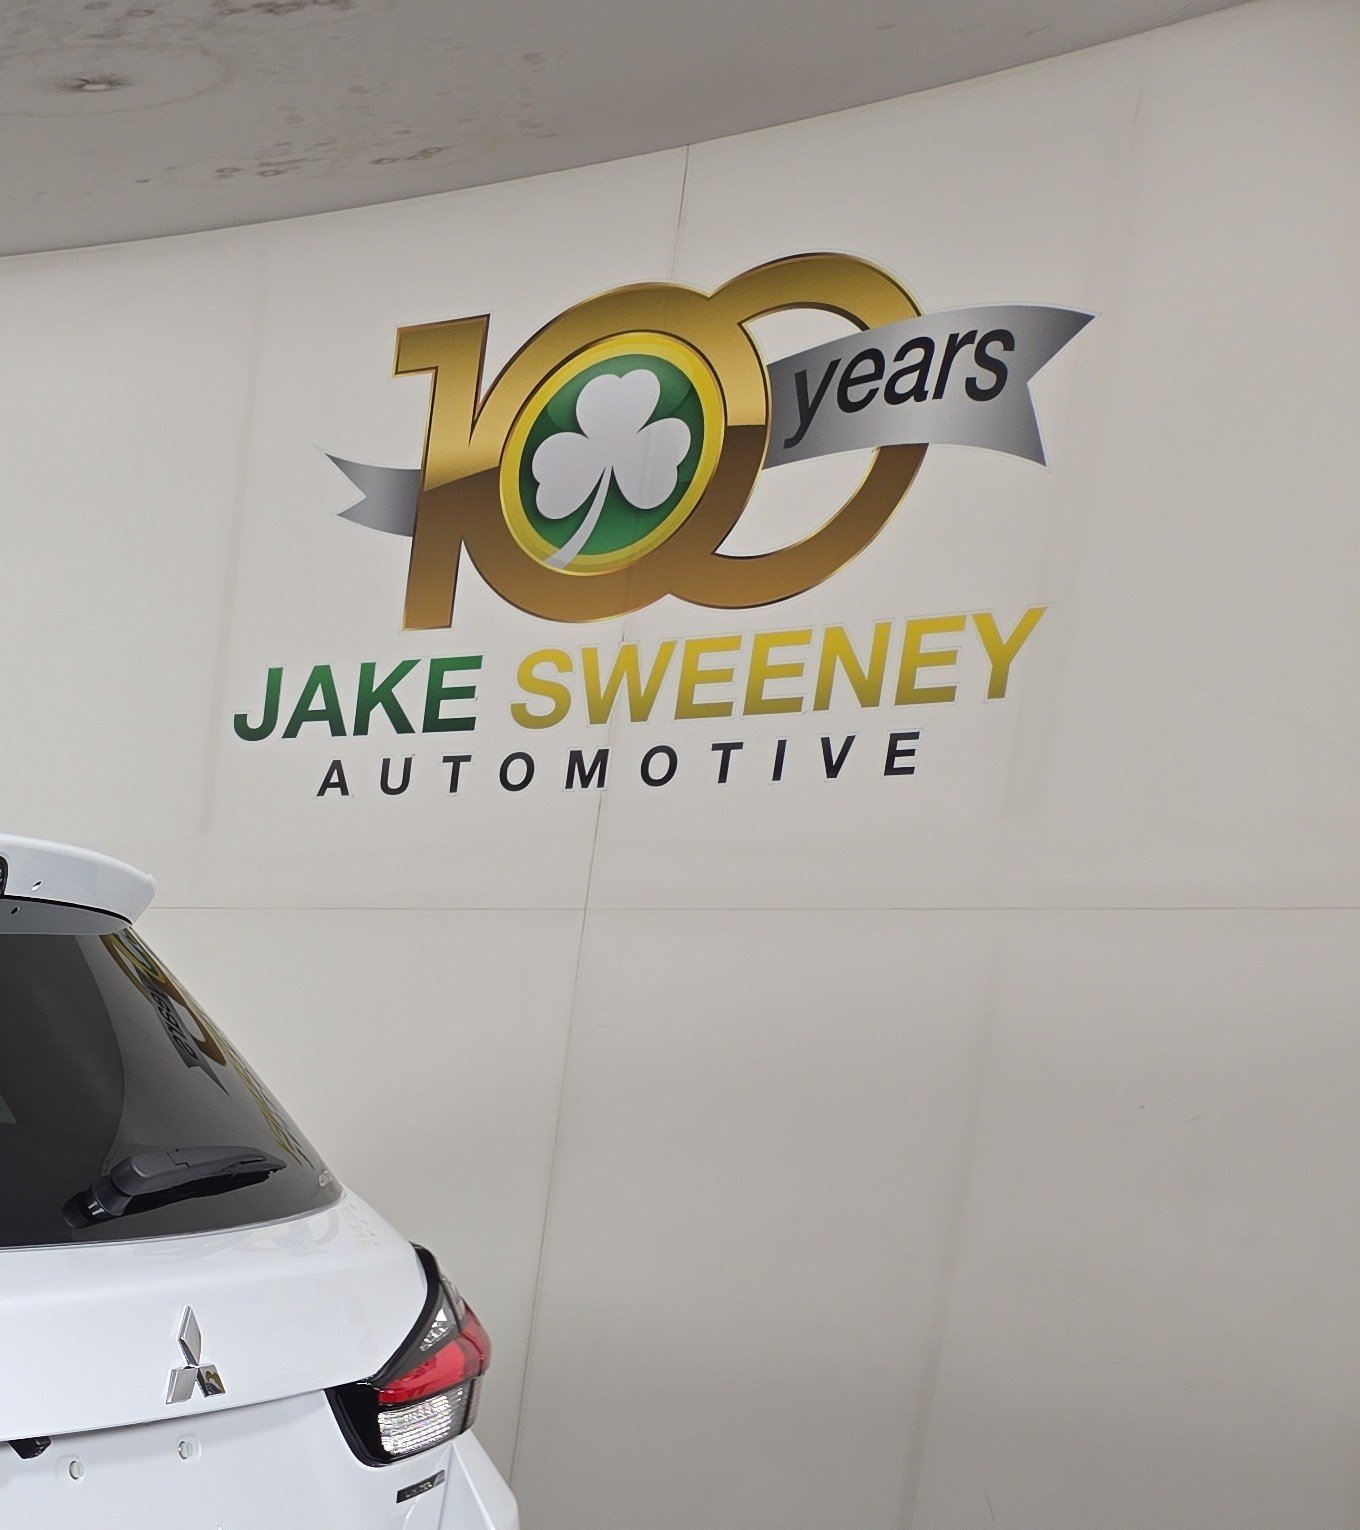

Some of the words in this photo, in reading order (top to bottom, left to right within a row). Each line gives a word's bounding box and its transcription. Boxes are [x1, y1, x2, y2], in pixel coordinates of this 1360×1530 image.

[784, 328, 1016, 449] years
[233, 655, 483, 742] JAKE
[510, 606, 1048, 730] SWEENEY
[317, 731, 922, 798] AUTOMOTIVE
